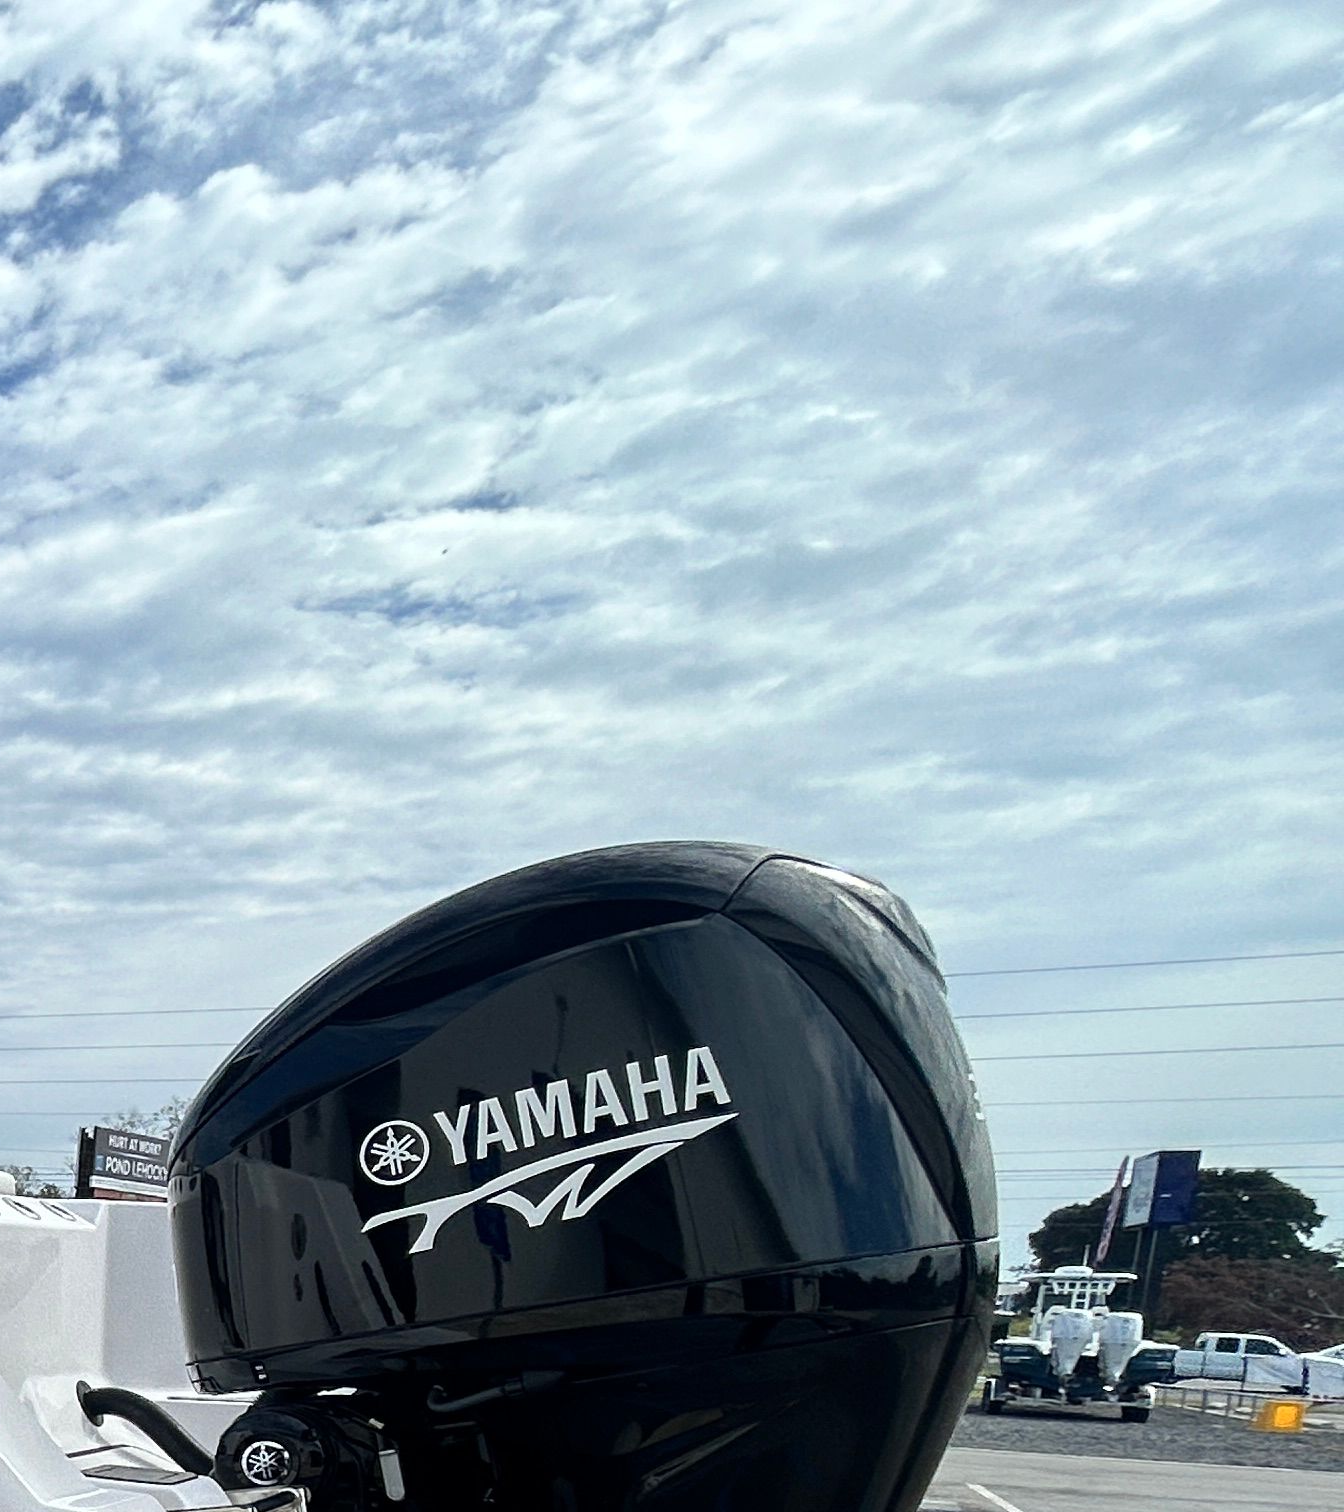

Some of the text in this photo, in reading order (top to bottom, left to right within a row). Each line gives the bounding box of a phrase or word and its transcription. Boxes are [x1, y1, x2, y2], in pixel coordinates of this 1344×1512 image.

[432, 1045, 732, 1167] YAMAHA
[129, 1138, 139, 1151] AT
[105, 1156, 131, 1176] POND
